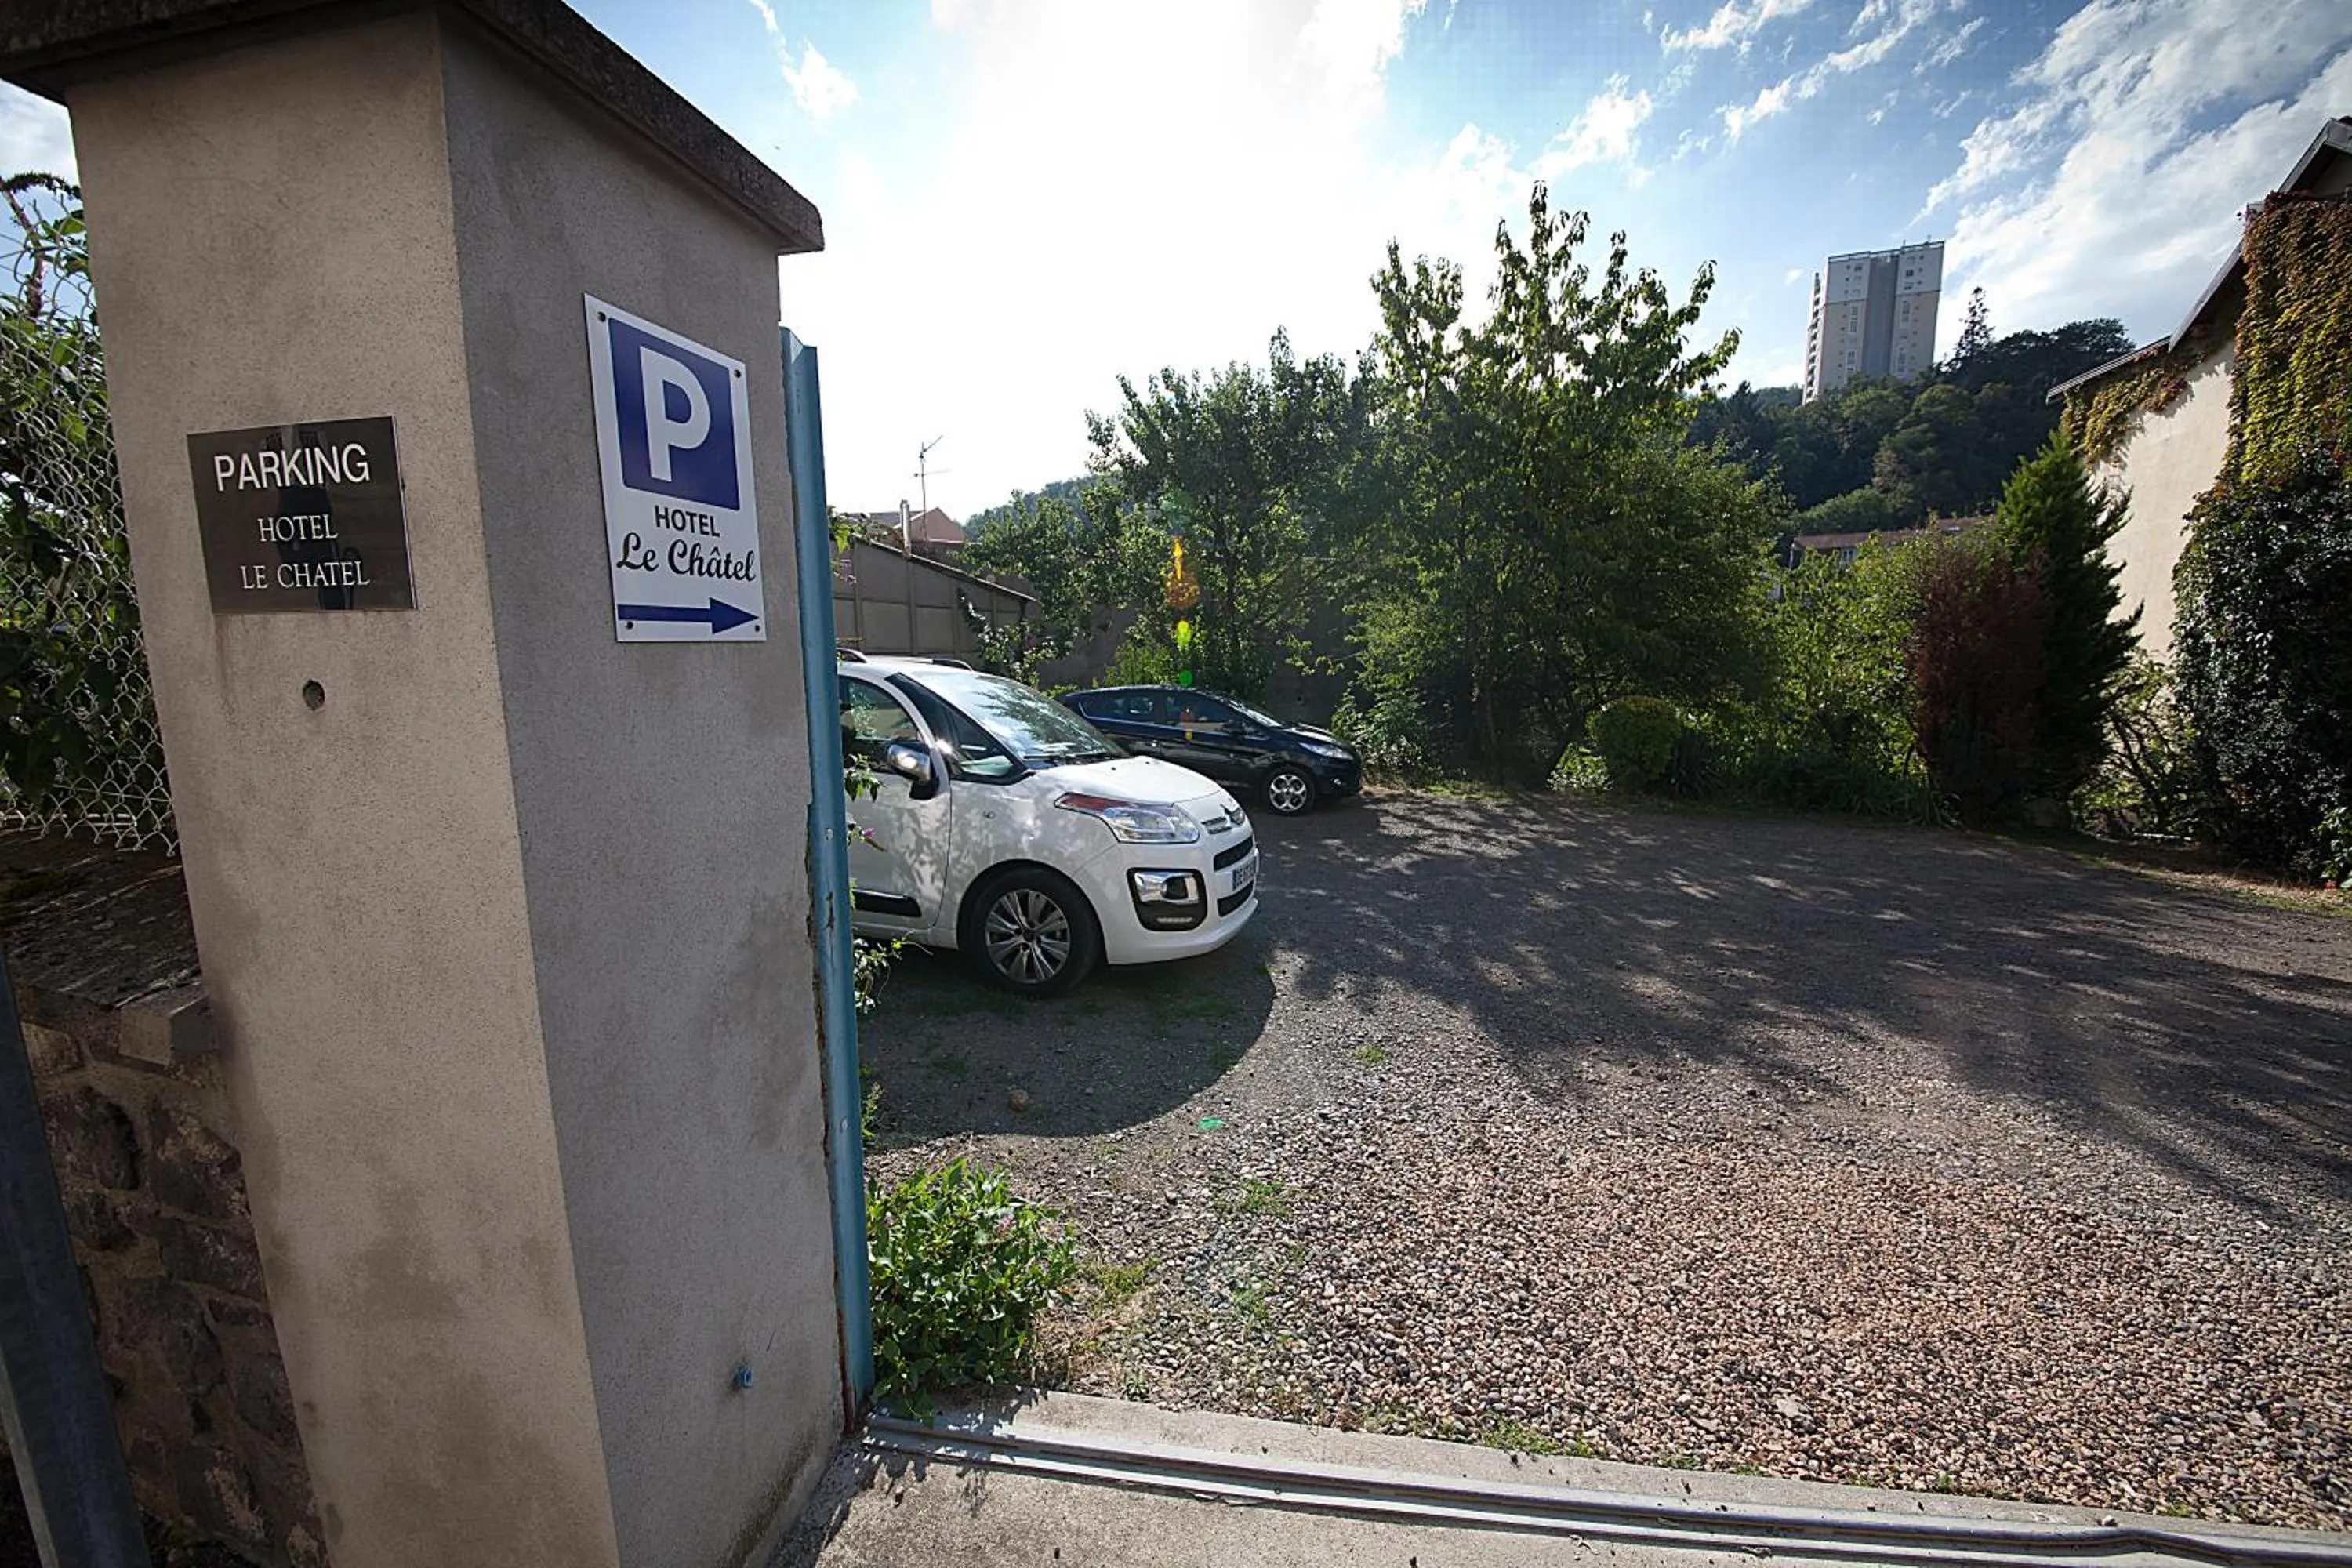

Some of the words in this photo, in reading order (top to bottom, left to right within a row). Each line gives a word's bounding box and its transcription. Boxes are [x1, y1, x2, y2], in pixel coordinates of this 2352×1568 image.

[640, 346, 711, 482] P
[213, 443, 370, 492] PARKING
[257, 514, 339, 542] HOTEL
[654, 504, 720, 538] HOTEL
[241, 564, 269, 589] LE
[276, 560, 371, 588] CHATEL
[615, 532, 659, 572] Le
[667, 538, 757, 583] Châtel
